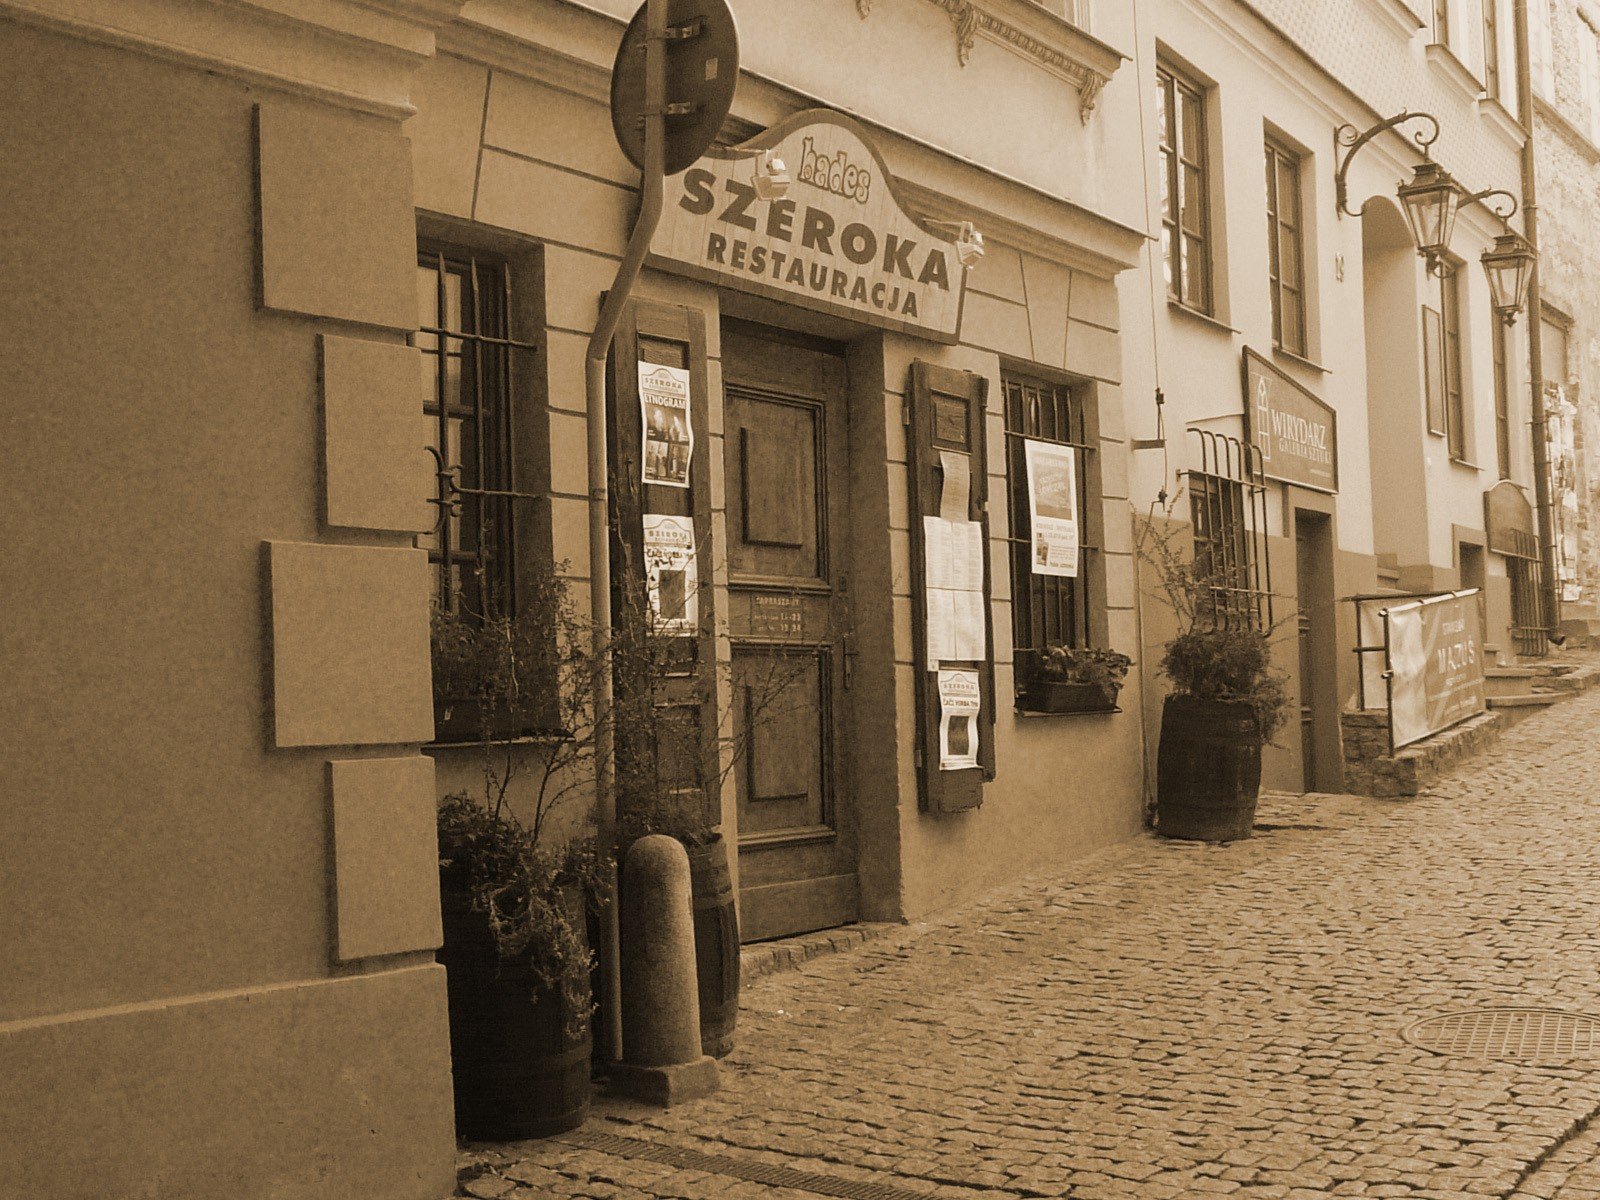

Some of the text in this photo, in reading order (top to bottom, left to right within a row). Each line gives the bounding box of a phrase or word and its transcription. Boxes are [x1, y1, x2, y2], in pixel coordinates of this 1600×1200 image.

[678, 167, 950, 292] SZEROKA
[706, 232, 919, 318] RESTAURACJA
[1270, 408, 1327, 450] WIRYDARZ
